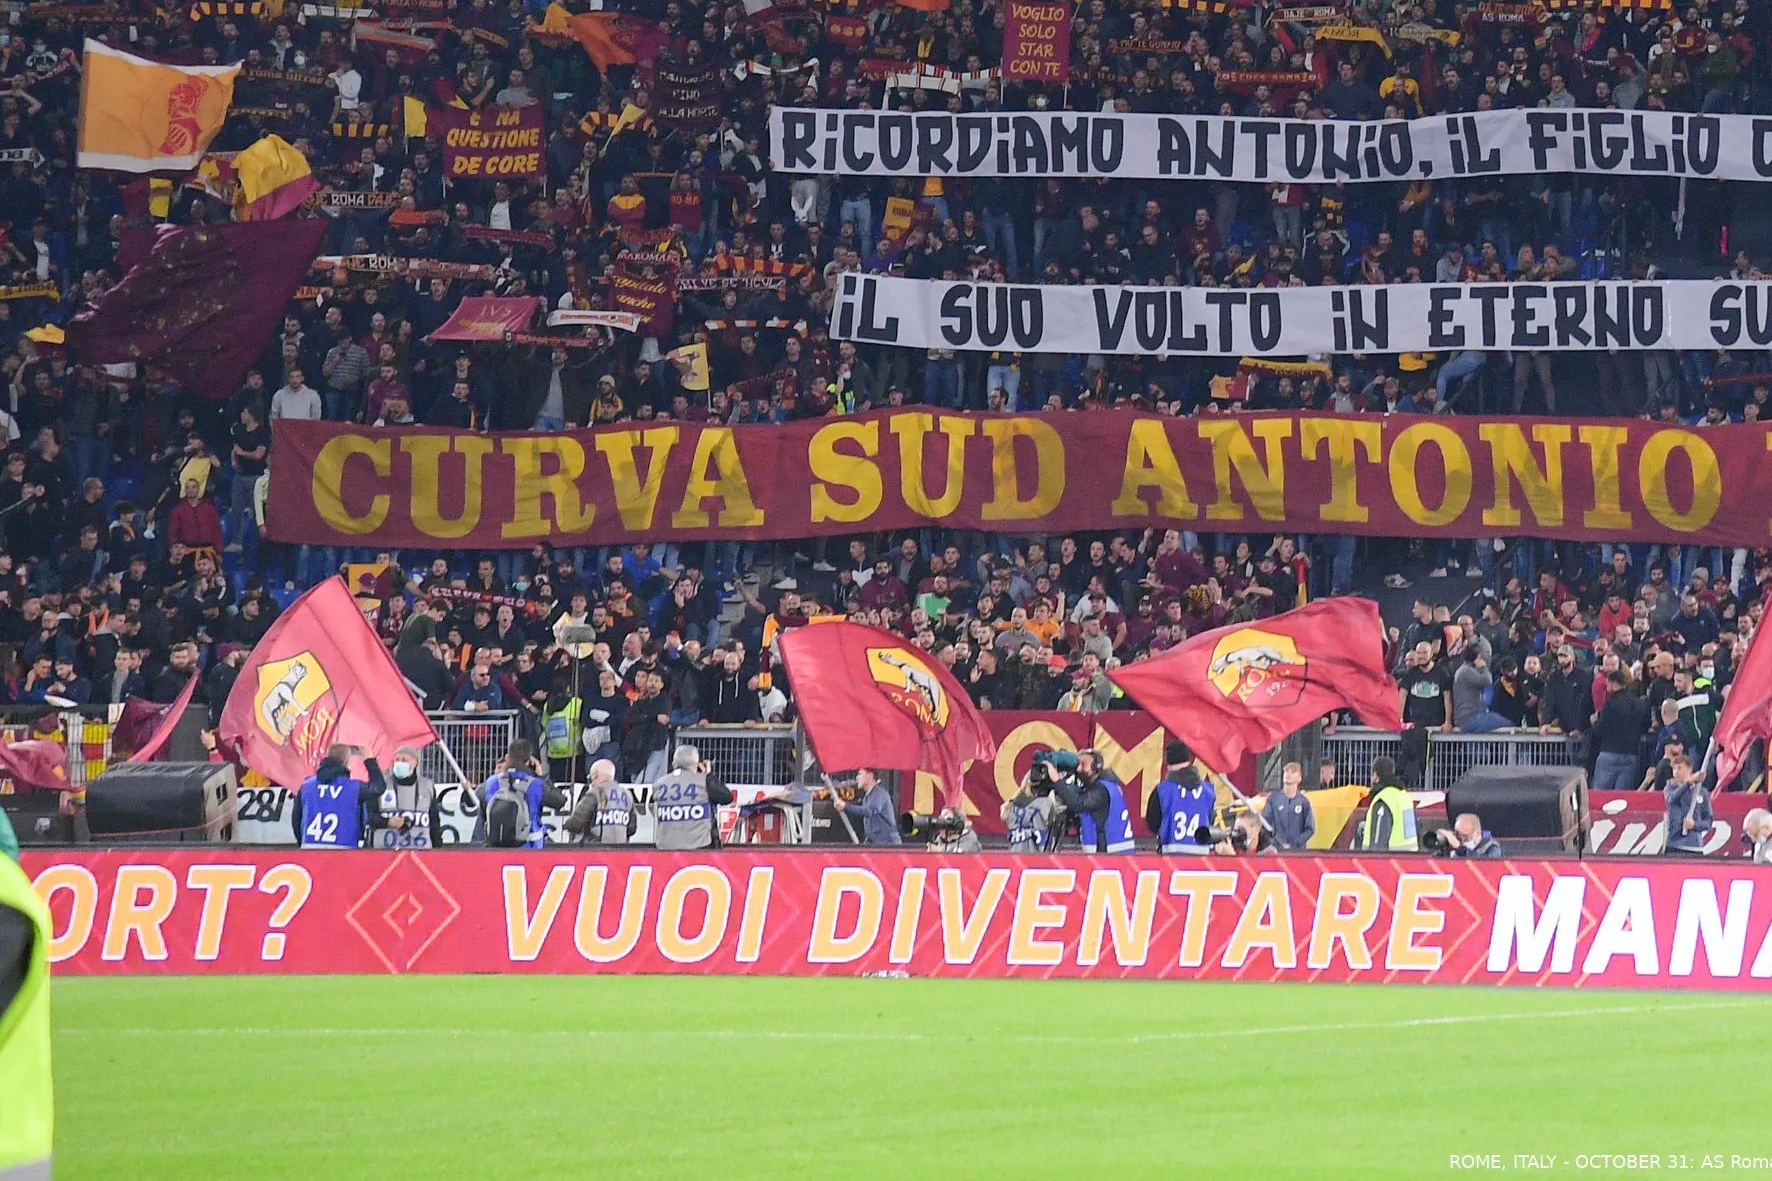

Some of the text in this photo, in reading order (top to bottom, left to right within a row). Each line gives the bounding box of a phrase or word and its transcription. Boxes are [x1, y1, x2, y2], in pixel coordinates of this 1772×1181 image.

[1010, 3, 1065, 22] VOGLIO
[1018, 23, 1058, 39] SOLO
[1017, 42, 1054, 58] STAR
[1009, 59, 1062, 76] CON TE
[446, 125, 540, 150] QUESTIONE
[452, 152, 541, 176] DE CORE
[331, 193, 365, 206] ROMA
[942, 283, 1045, 347] SUO
[1093, 288, 1282, 352] VOLTO
[1428, 284, 1663, 349] ETERNO
[312, 426, 766, 539] CURVA
[811, 412, 1066, 523] SUD
[1111, 413, 1722, 532] ANTONIO
[317, 784, 342, 800] TV
[659, 783, 698, 801] 234
[657, 804, 704, 821] PHOTO
[306, 812, 338, 843] 42
[1174, 811, 1199, 838] 34
[384, 830, 427, 847] 036
[30, 864, 312, 963] ORT?
[502, 864, 775, 963] VUOI
[805, 866, 1456, 972] DIVENTARE
